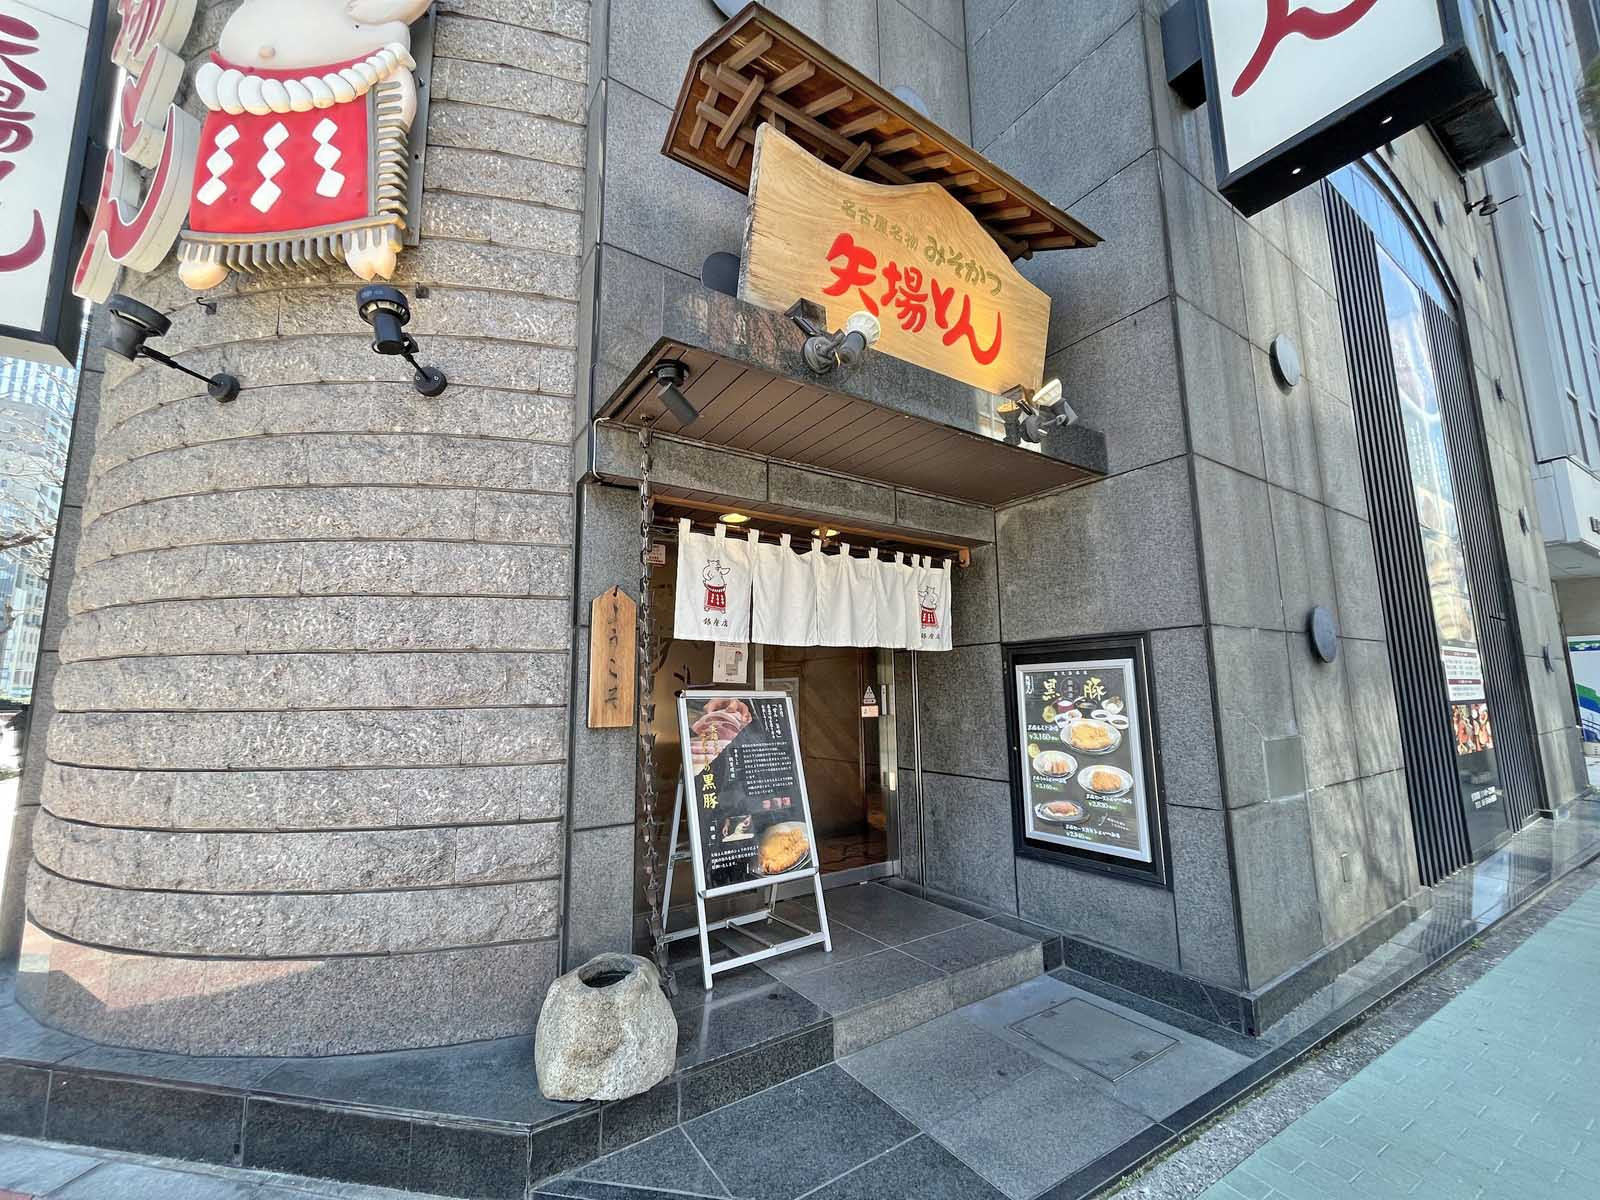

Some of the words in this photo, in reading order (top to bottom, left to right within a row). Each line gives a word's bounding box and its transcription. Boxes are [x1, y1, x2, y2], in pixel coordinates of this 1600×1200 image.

[821, 232, 1002, 366] 矢場とん
[841, 199, 918, 251] 名古屋名物
[924, 234, 1002, 297] みそかつ
